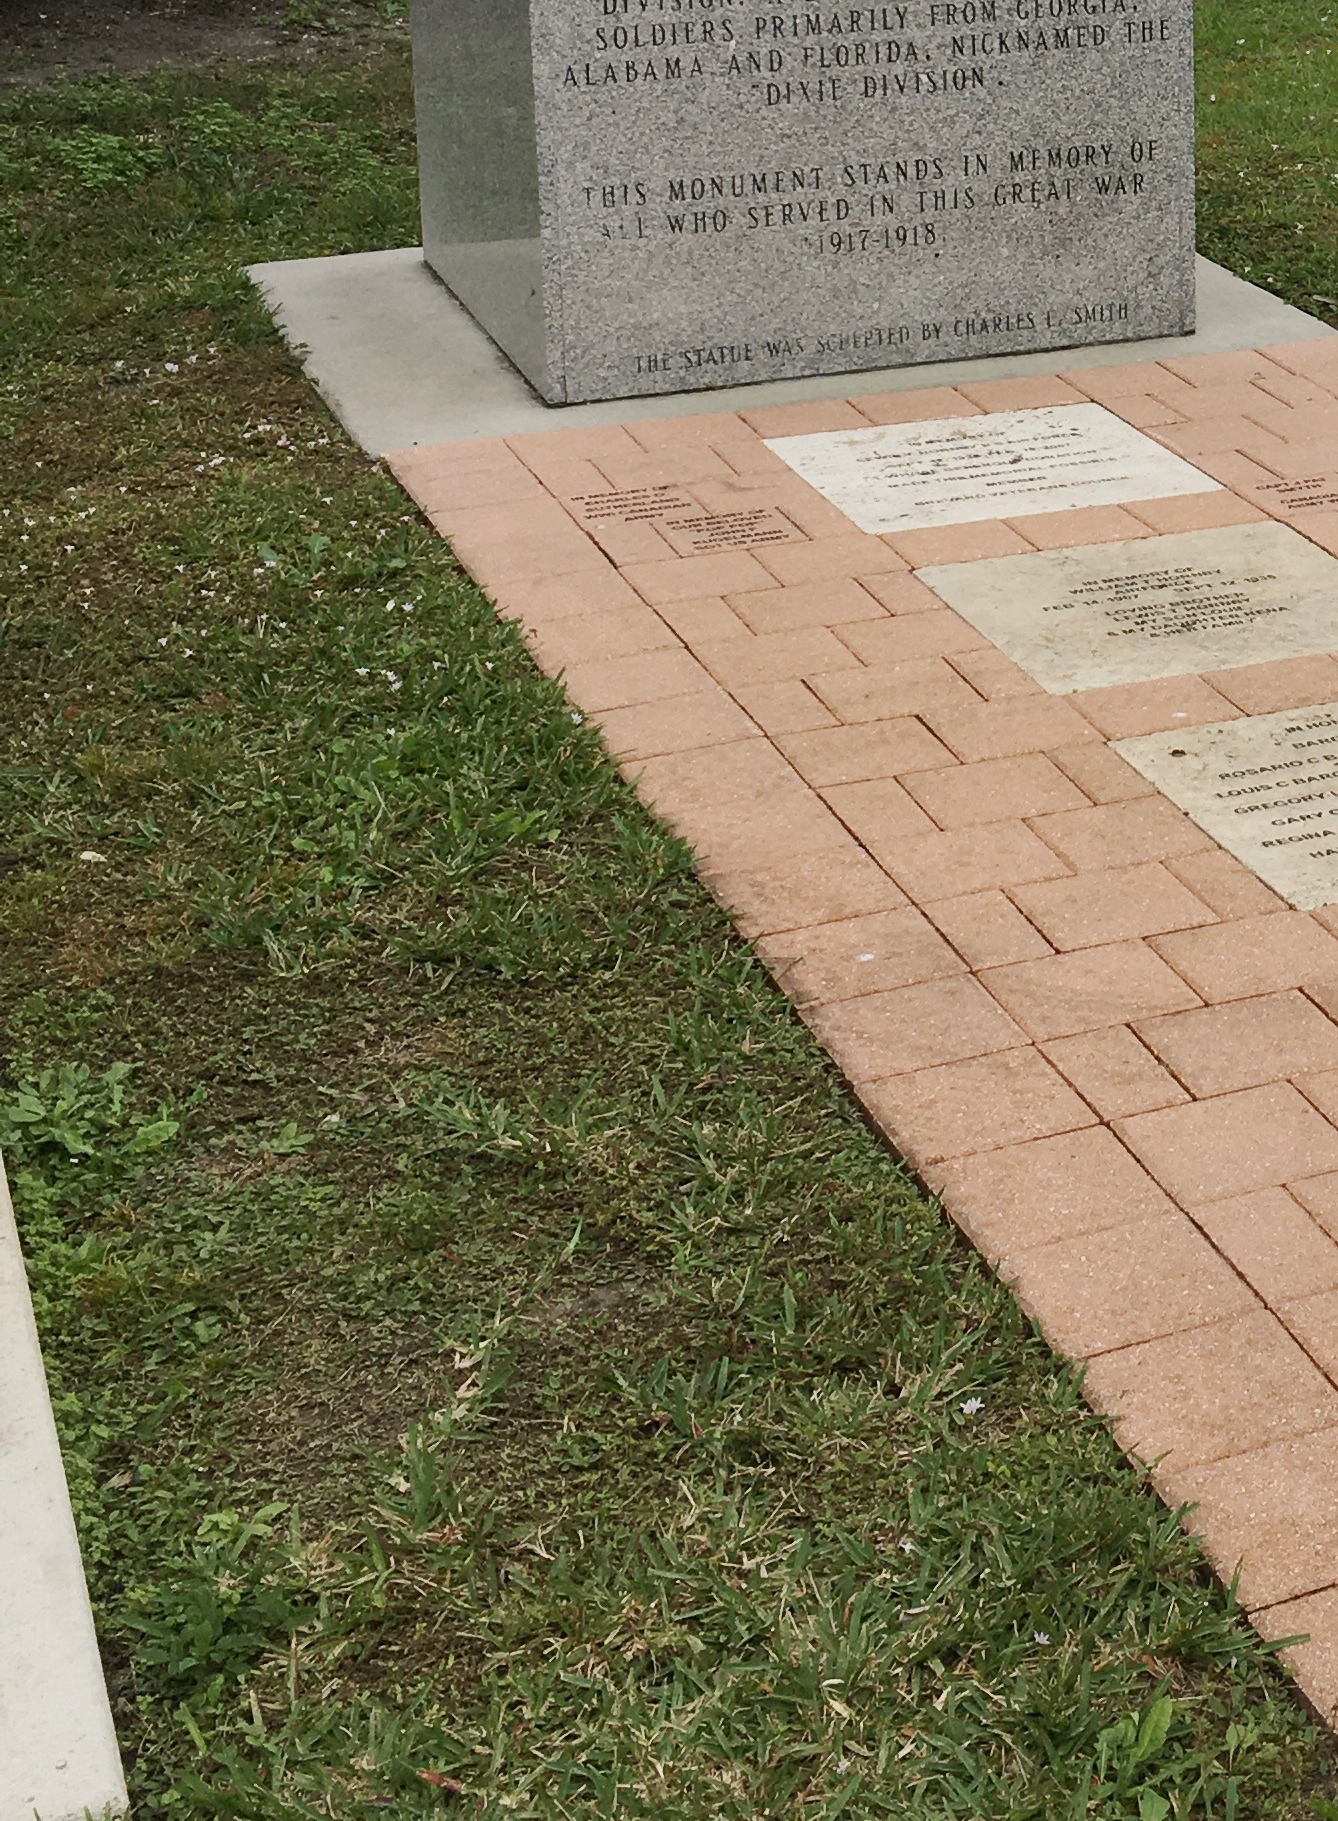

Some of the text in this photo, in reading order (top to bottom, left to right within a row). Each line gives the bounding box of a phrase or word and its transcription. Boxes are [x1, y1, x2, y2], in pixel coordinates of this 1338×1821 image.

[561, 53, 703, 89] ALABAMA
[728, 47, 784, 76] AND
[950, 23, 1105, 59] NICKNAMED
[1124, 18, 1171, 45] THE
[594, 17, 733, 52] SOLDIERS
[754, 5, 908, 40] PRIMARILY
[930, 0, 997, 28] FROM
[582, 135, 1159, 213] THIS MONUMENT STANDS IN MEMORY OF
[667, 209, 728, 240] WHO
[747, 197, 850, 232] SERVED
[869, 192, 896, 220] IN
[918, 185, 974, 215] THIS
[993, 175, 1073, 207] GREAT
[1094, 168, 1145, 197] WAR
[817, 221, 936, 257] 1917-1918
[634, 353, 671, 379] THE
[679, 344, 752, 373] STATUE
[766, 337, 805, 363] WAS
[922, 321, 943, 344] BY
[953, 310, 1036, 340] CHARLES
[1074, 299, 1129, 326] SMITH
[1284, 725, 1304, 734] IN
[1215, 784, 1273, 799] LOUIS
[1275, 780, 1290, 788] C
